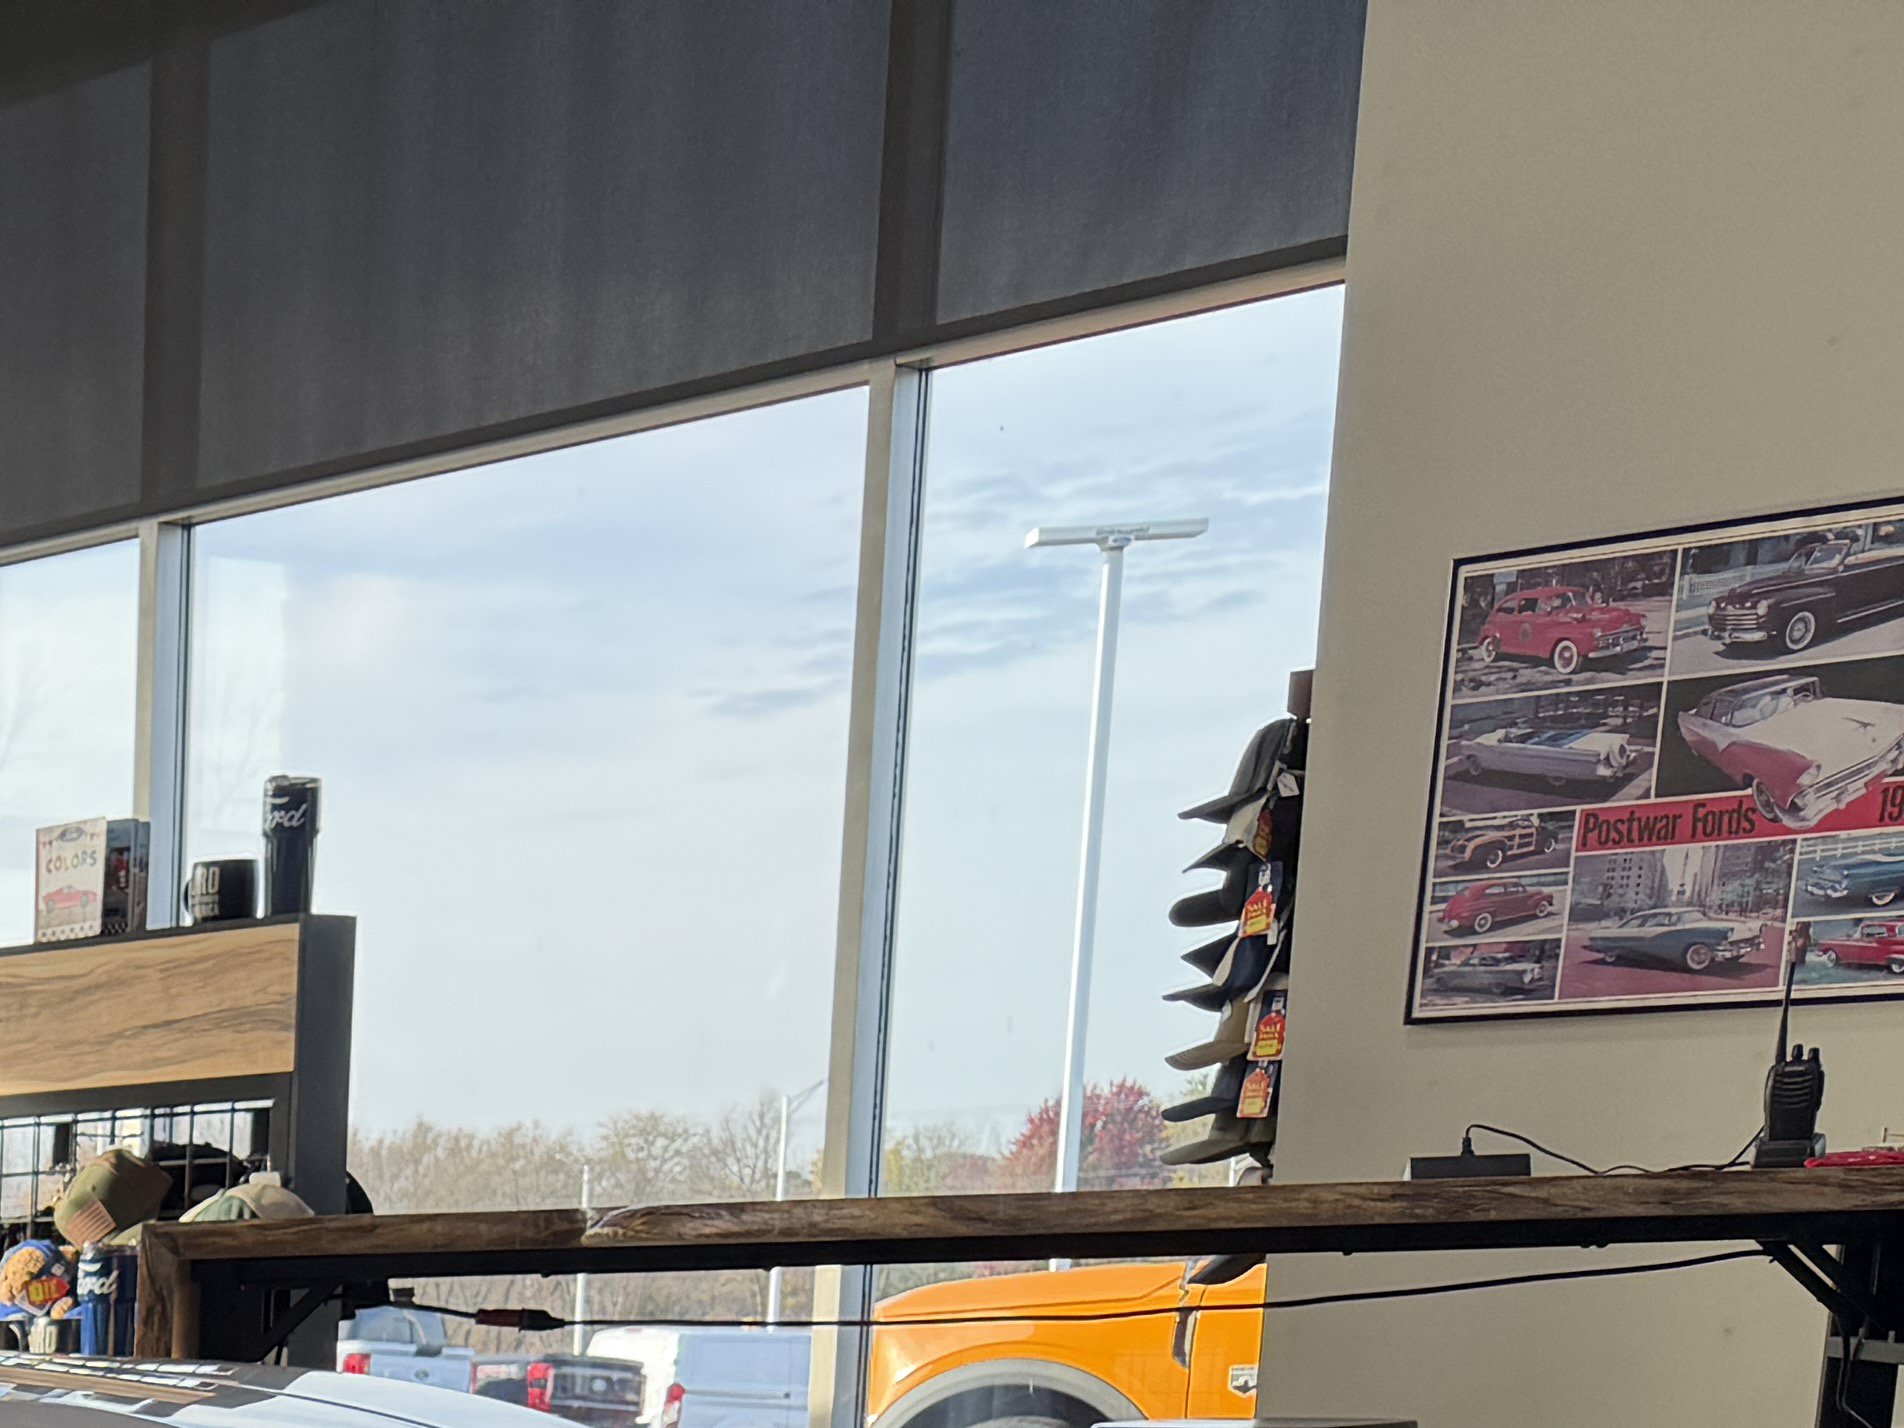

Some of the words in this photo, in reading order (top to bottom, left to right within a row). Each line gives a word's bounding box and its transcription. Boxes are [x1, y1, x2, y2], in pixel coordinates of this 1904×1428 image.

[1581, 810, 1683, 848] Postwar
[1692, 800, 1758, 839] Fords
[45, 850, 98, 874] COLORS
